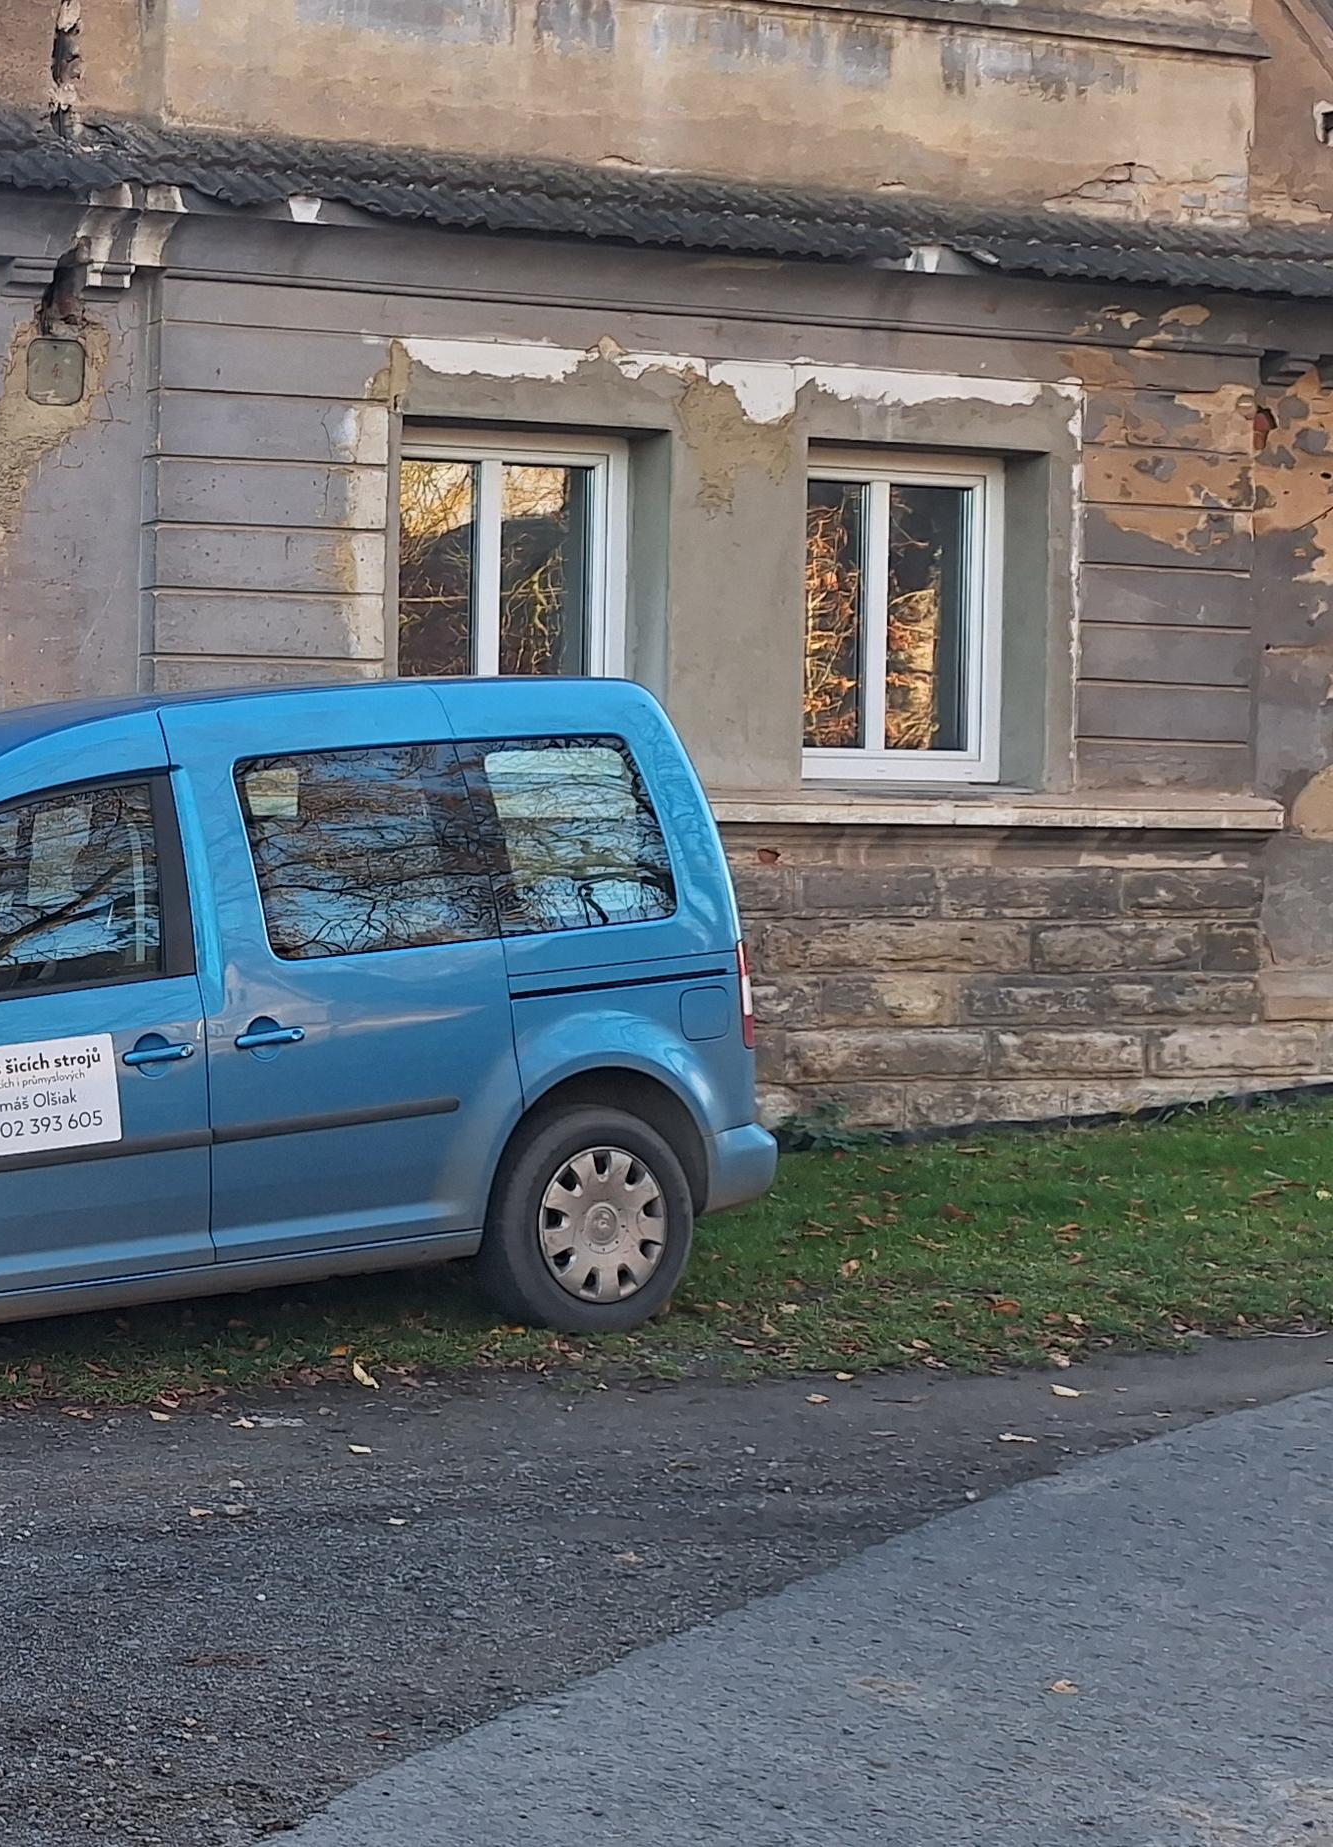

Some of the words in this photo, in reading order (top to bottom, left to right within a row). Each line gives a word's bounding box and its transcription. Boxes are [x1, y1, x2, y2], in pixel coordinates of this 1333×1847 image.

[5, 1053, 50, 1074] šicích
[54, 1047, 101, 1069] strojů
[33, 1088, 77, 1108] Olšiak
[30, 1115, 63, 1135] 393
[68, 1110, 103, 1130] 605
